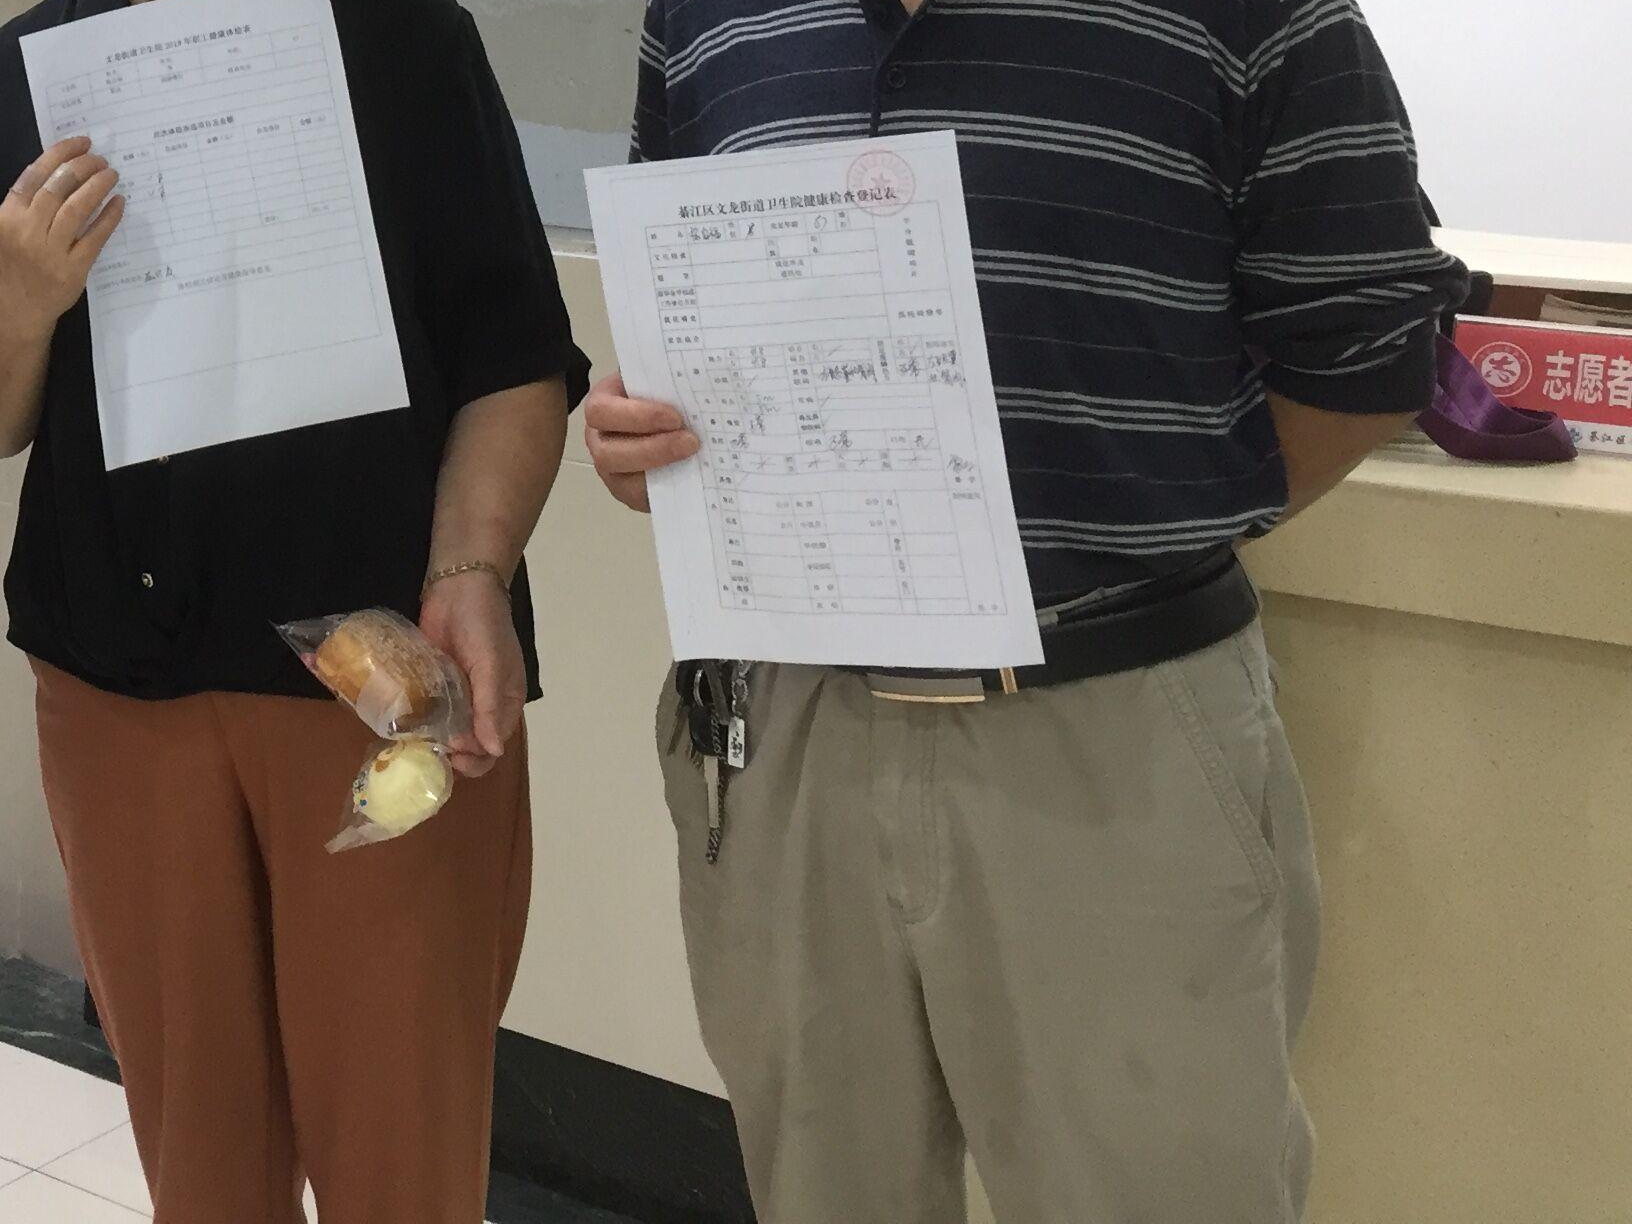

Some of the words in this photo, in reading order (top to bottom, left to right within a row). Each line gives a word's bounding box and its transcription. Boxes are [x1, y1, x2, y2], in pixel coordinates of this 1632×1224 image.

[678, 186, 897, 219] 綦江区文龙街道卫生院健康检查登记表
[1542, 350, 1632, 408] 志愿者
